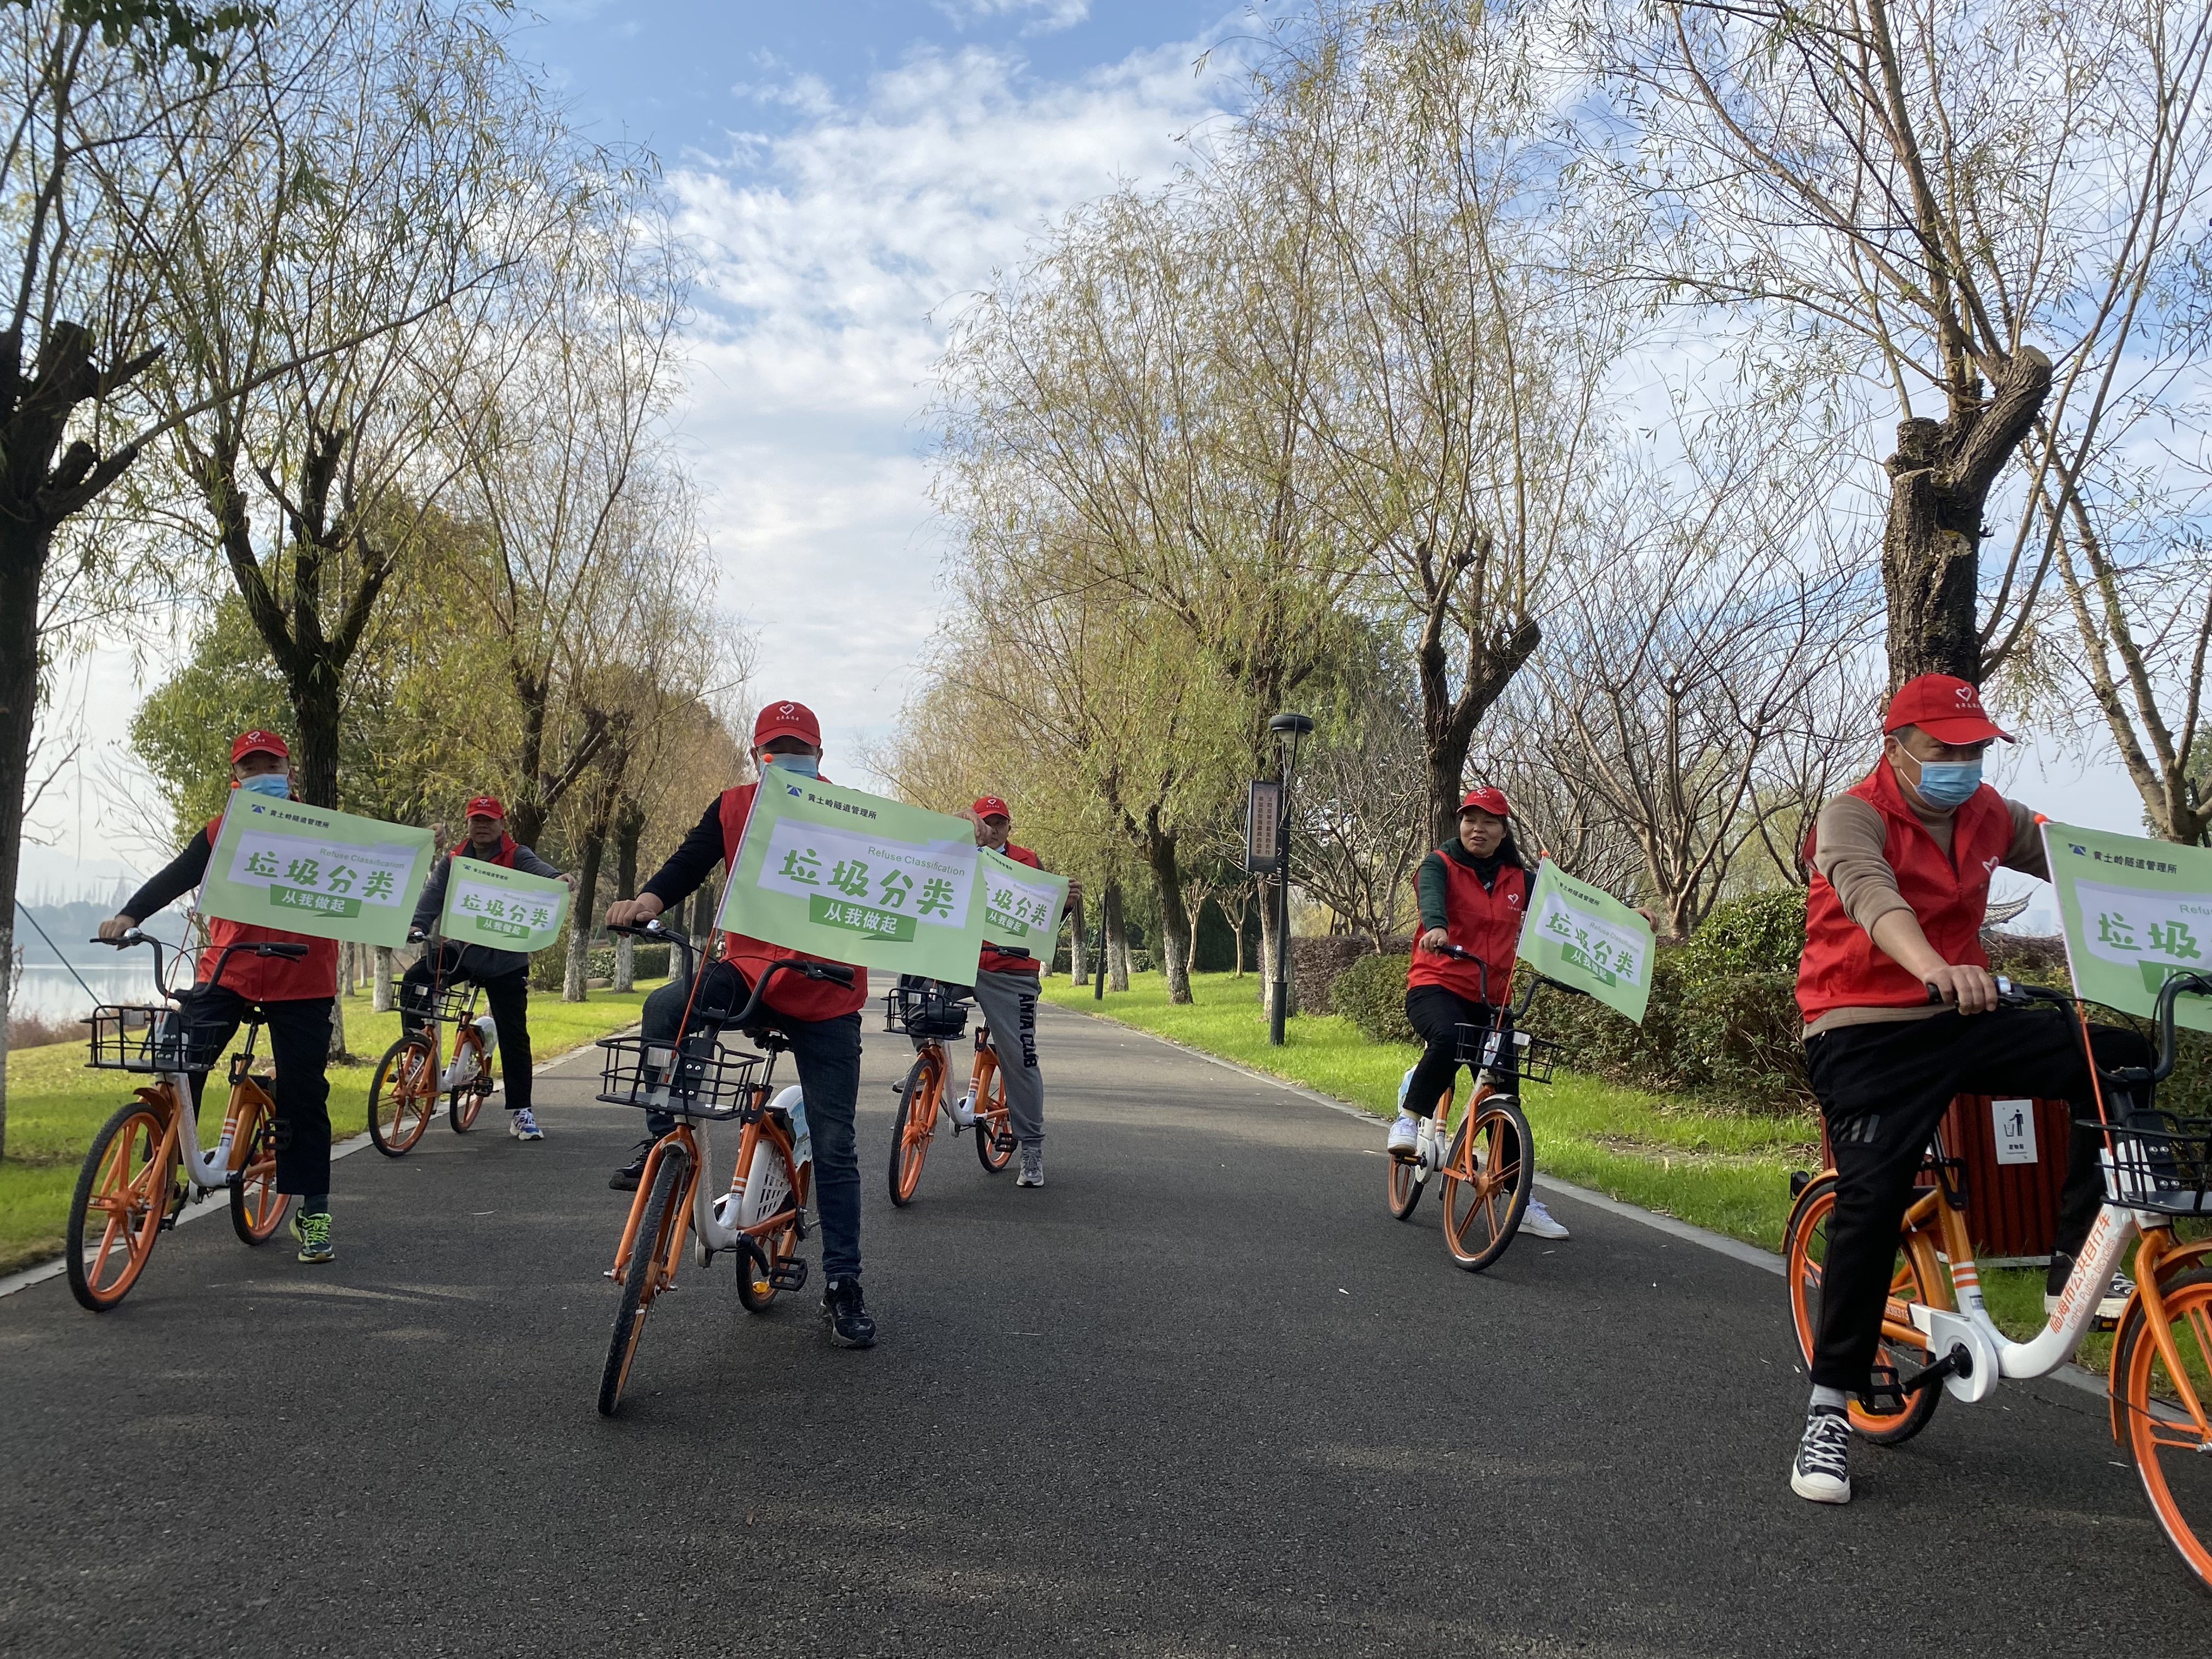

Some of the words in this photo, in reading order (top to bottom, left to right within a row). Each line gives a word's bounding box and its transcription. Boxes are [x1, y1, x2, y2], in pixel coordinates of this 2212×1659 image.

[270, 809, 329, 828] 黄土岭隧道管理所
[808, 793, 877, 820] 黄土岭隧道管理所
[320, 848, 349, 860] Refuse
[351, 854, 404, 869] Classification
[868, 847, 902, 862] Refuse
[905, 856, 965, 876] Classification
[2094, 850, 2177, 874] 黄土岭隧道管理所
[244, 851, 394, 900] 垃圾分类
[778, 848, 955, 918] 垃圾分类
[282, 889, 346, 913] 从我做起
[986, 881, 1047, 926] 圾分类
[1559, 882, 1600, 907] 黄土岭隧道管理所
[460, 894, 549, 928] 垃圾分类
[823, 902, 898, 935] 从我做起
[988, 911, 1022, 933] 从我做起
[2179, 904, 2212, 915] Refu
[483, 919, 521, 935] 从我做起
[1589, 922, 1609, 936] Refuse
[1610, 932, 1639, 953] Classification
[2049, 1213, 2111, 1334] 临海市公共自行车
[2066, 1301, 2085, 1330] LinHai
[2080, 1273, 2098, 1301] Public
[2092, 1238, 2115, 1274] bicycles
